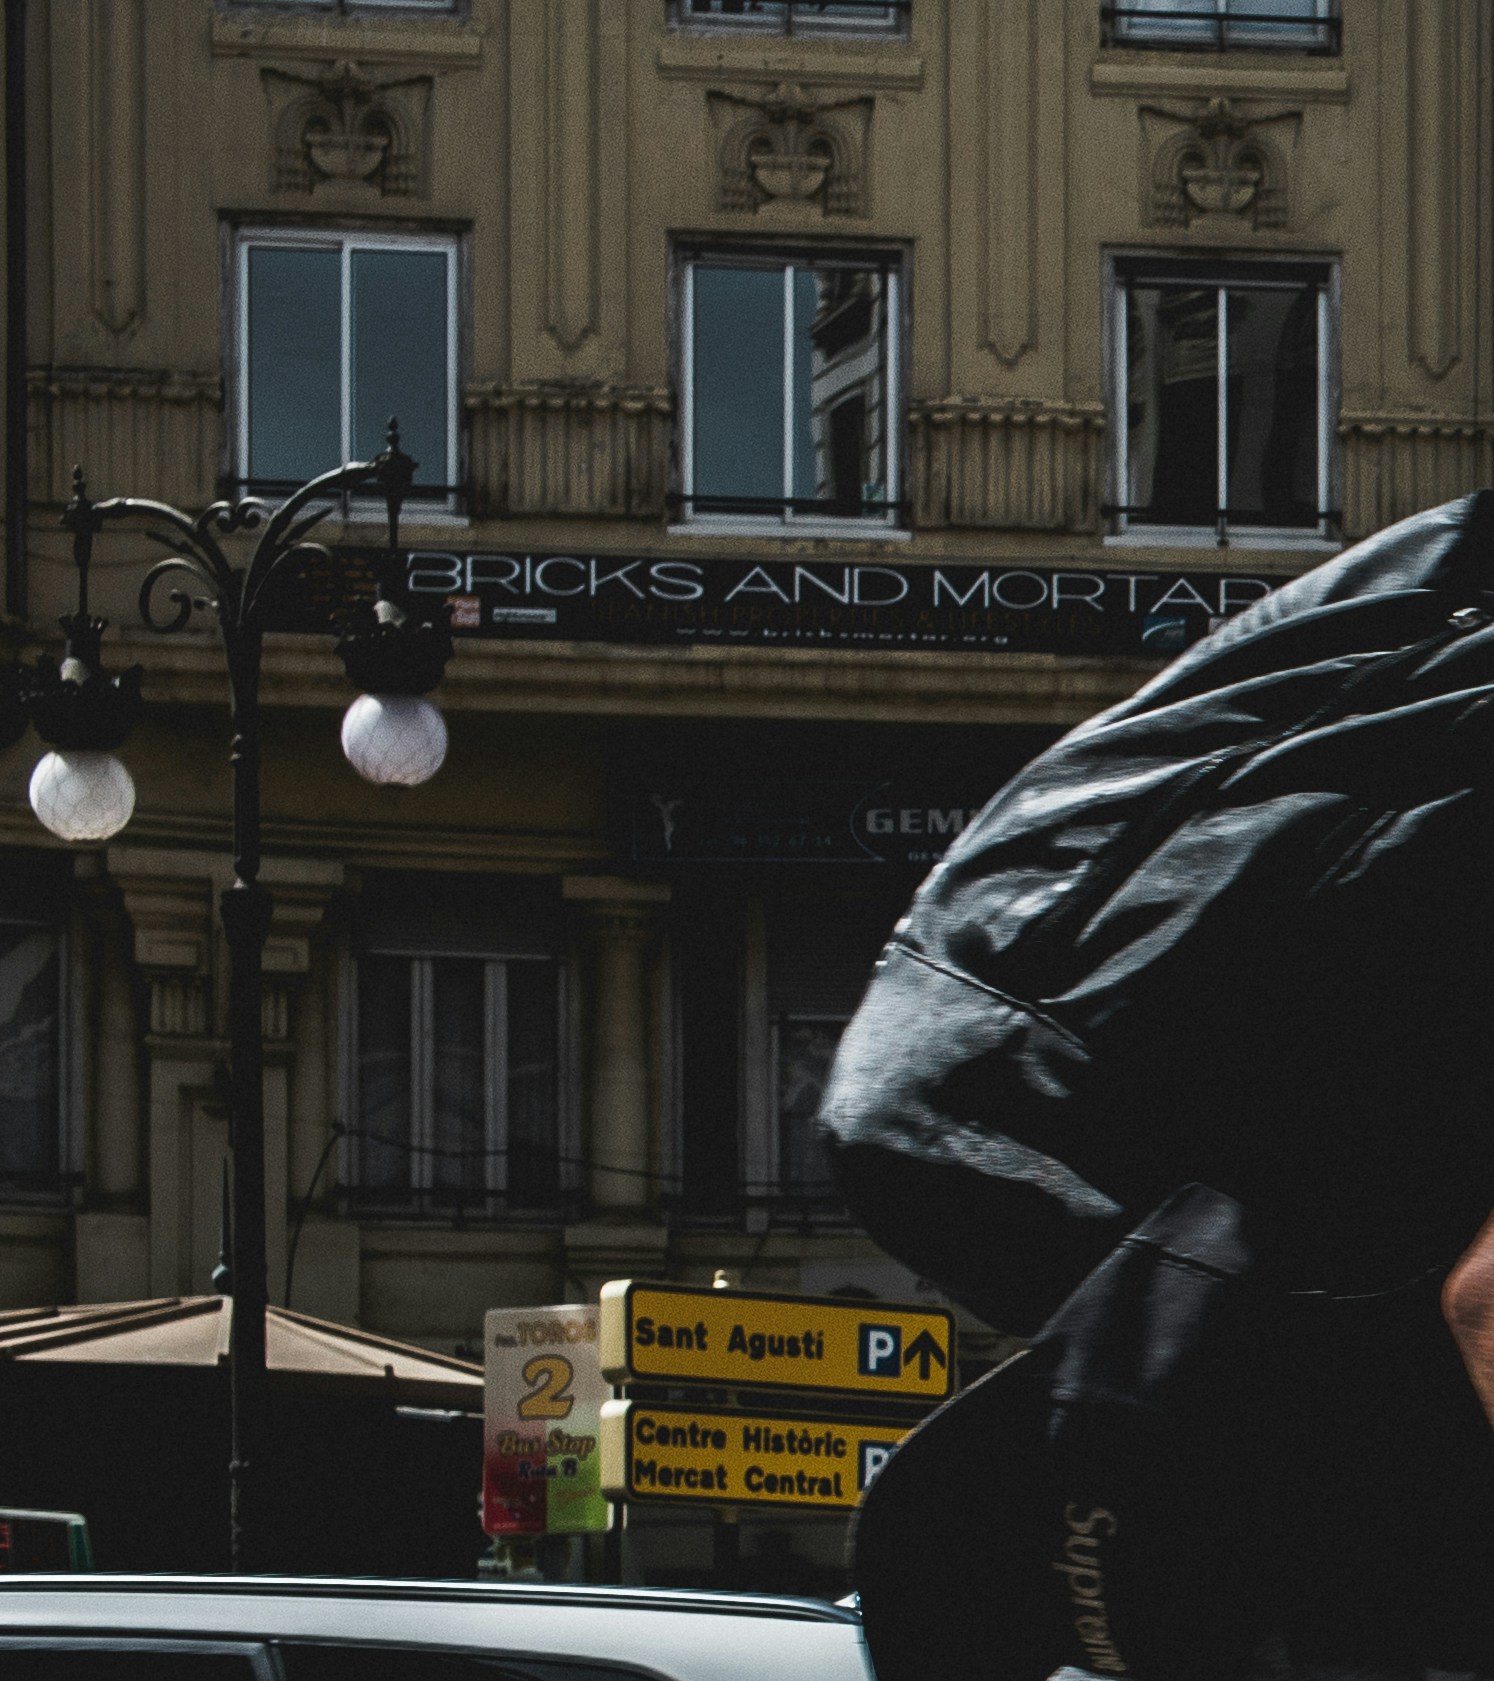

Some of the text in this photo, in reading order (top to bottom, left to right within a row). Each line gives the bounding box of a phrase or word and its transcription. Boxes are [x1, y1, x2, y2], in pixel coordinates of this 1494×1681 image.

[406, 551, 704, 602] BRICKS
[723, 565, 910, 608] AND
[865, 808, 981, 835] GEM
[636, 1316, 896, 1371] Sant Agustí P
[518, 1353, 575, 1420] 2
[546, 1427, 597, 1462] Stop
[636, 1418, 726, 1450] Centre
[742, 1423, 848, 1459] Històric
[635, 1459, 843, 1498] Mercat Central
